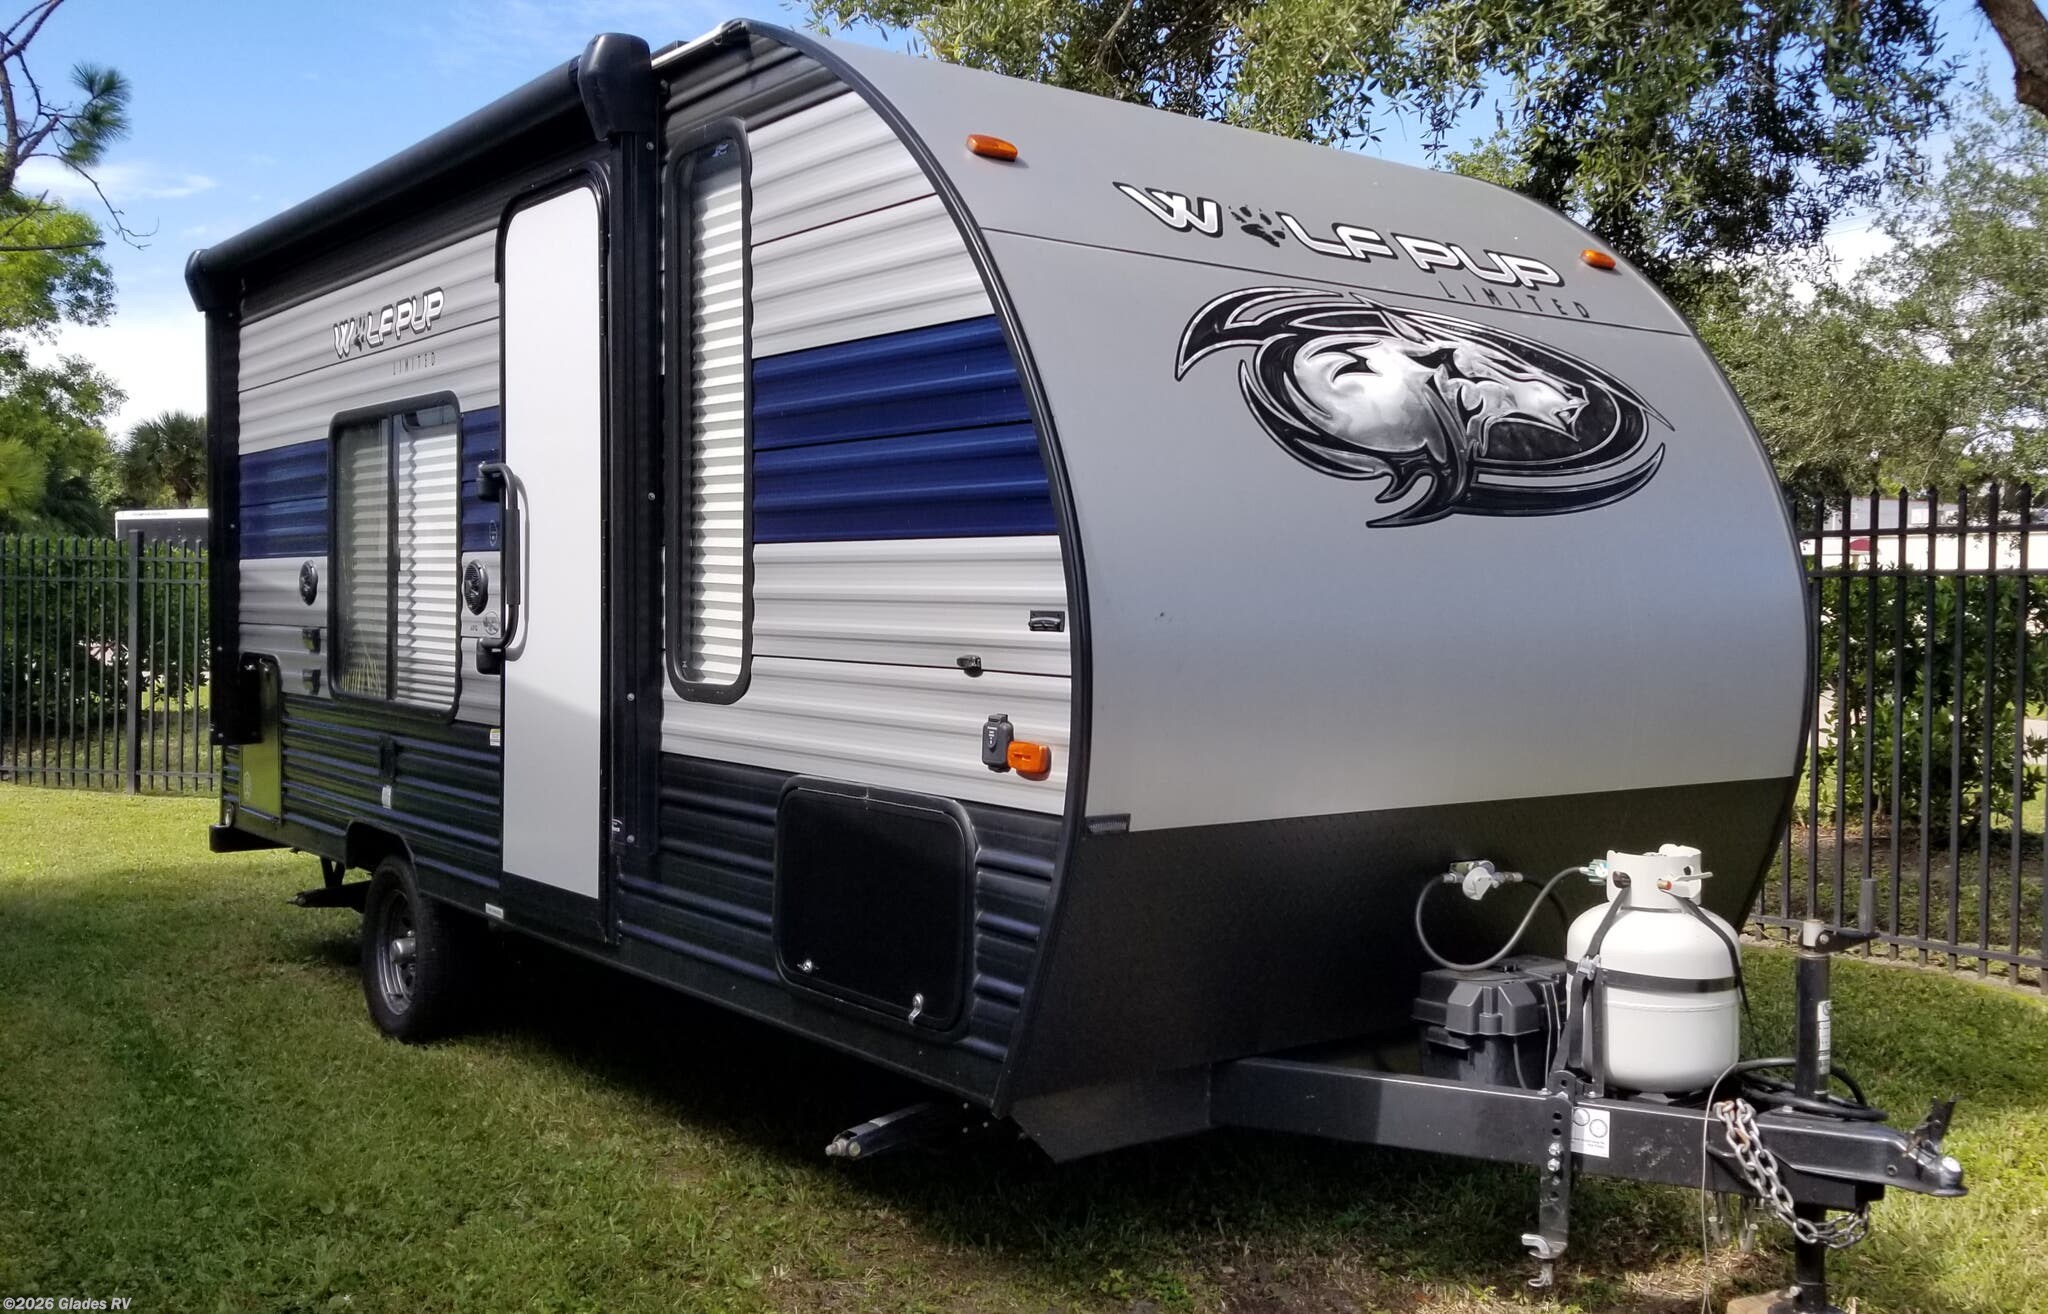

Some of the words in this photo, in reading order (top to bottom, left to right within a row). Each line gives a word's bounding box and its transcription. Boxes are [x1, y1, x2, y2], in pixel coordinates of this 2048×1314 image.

[1112, 181, 1398, 263] WLF
[1390, 232, 1565, 291] PUP
[333, 304, 394, 359] WLF
[395, 286, 444, 341] PUP
[1438, 280, 1590, 319] LIMITED
